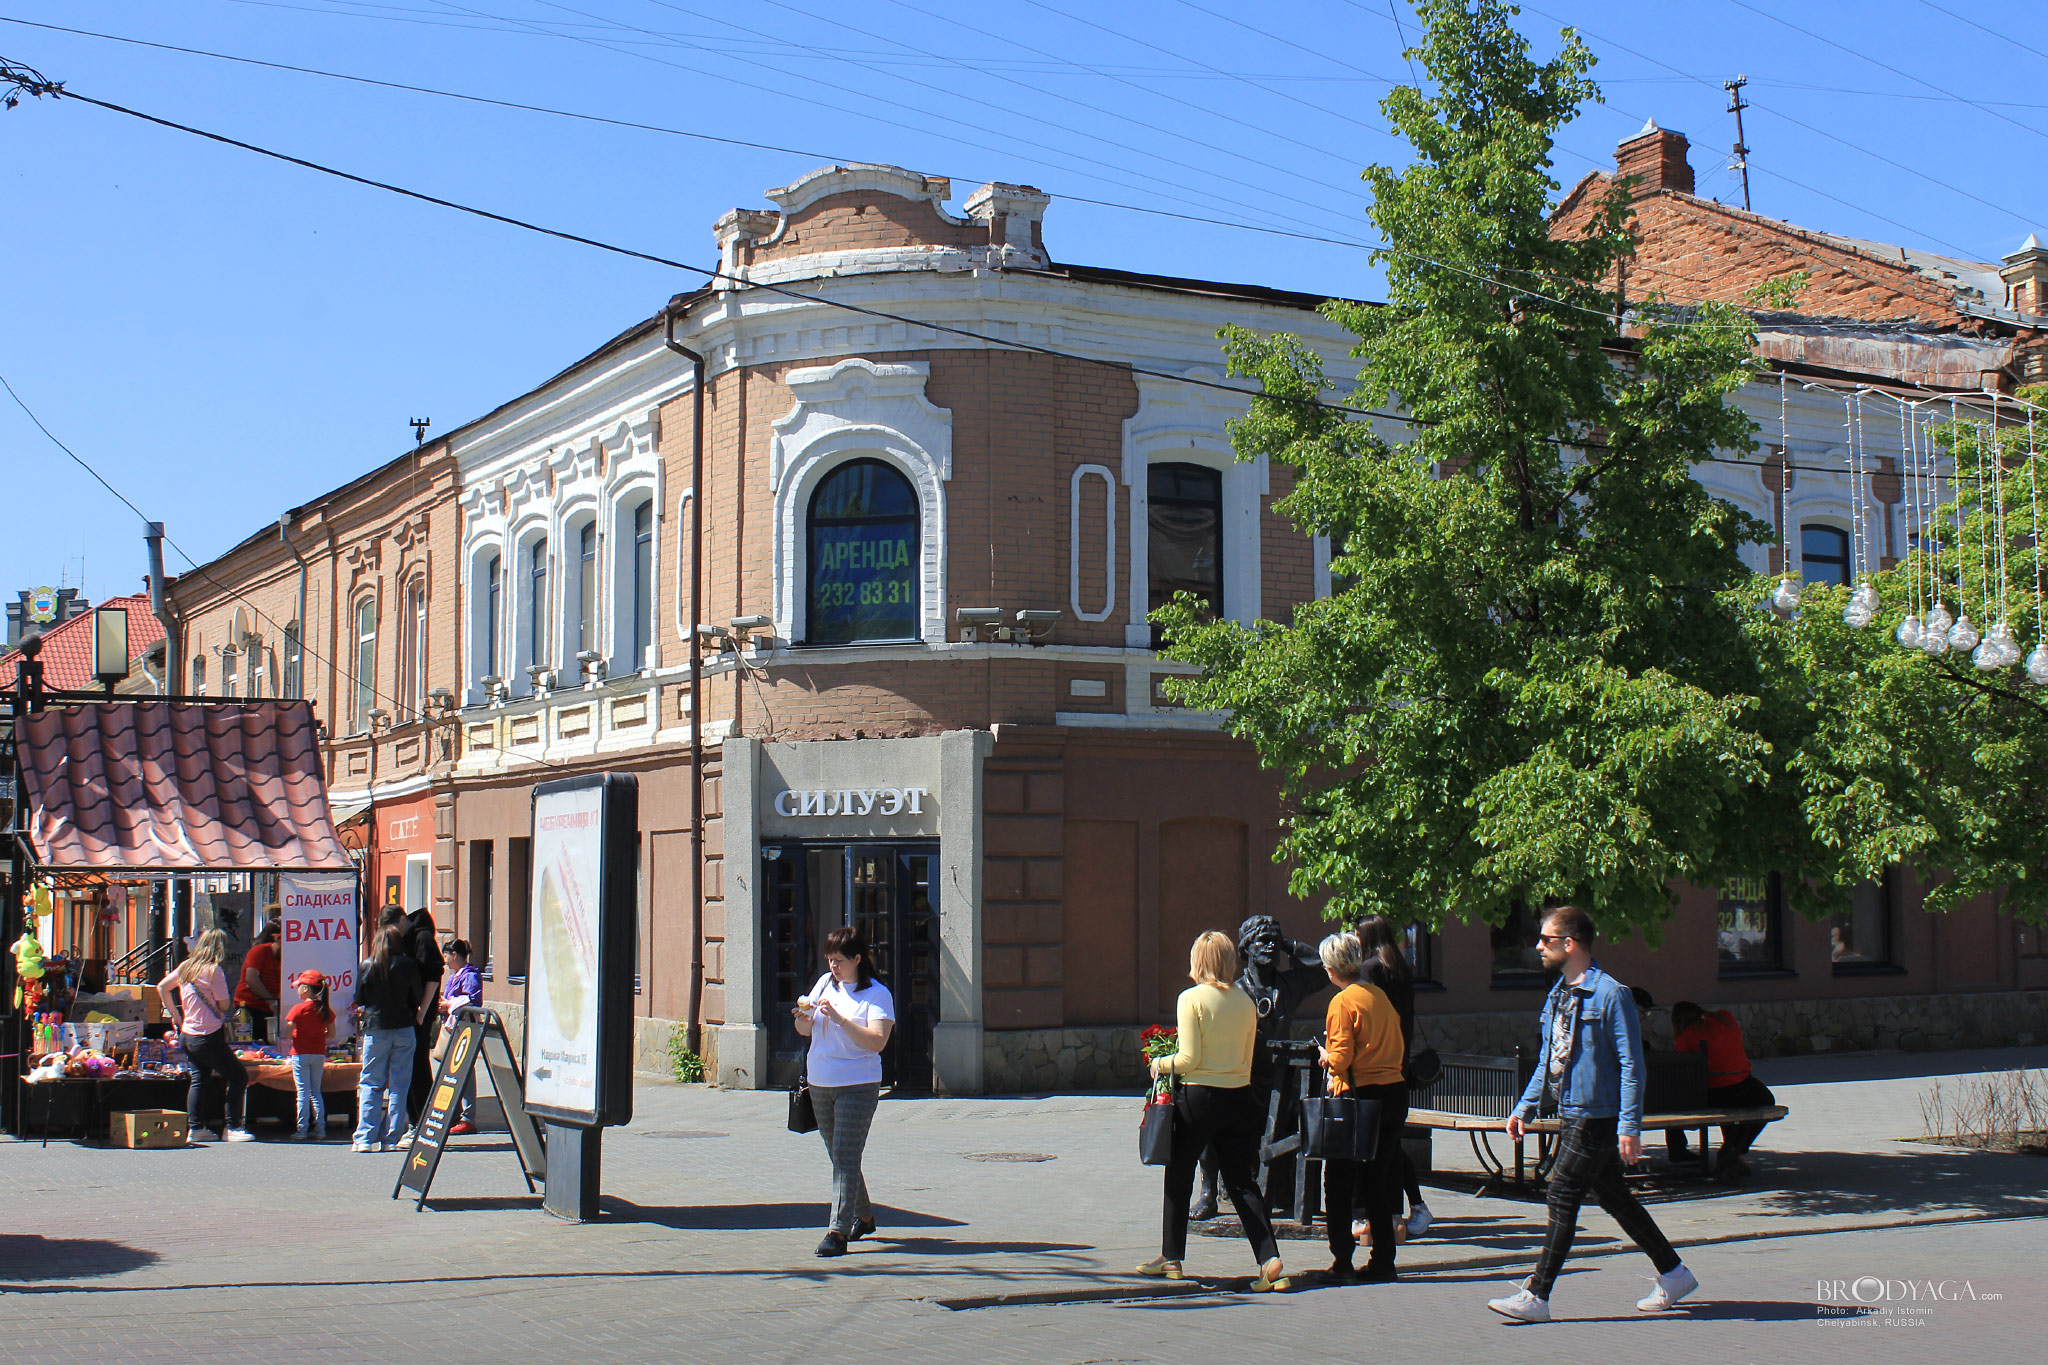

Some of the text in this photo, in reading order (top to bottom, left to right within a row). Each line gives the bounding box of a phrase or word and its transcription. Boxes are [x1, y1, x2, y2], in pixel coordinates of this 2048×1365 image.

[821, 539, 909, 570] АРЕНДА
[820, 579, 910, 606] 232 83 31
[774, 787, 928, 817] СИЛУЭТ
[286, 893, 352, 908] СЛАДКАЯ
[286, 918, 352, 942] ВАТА
